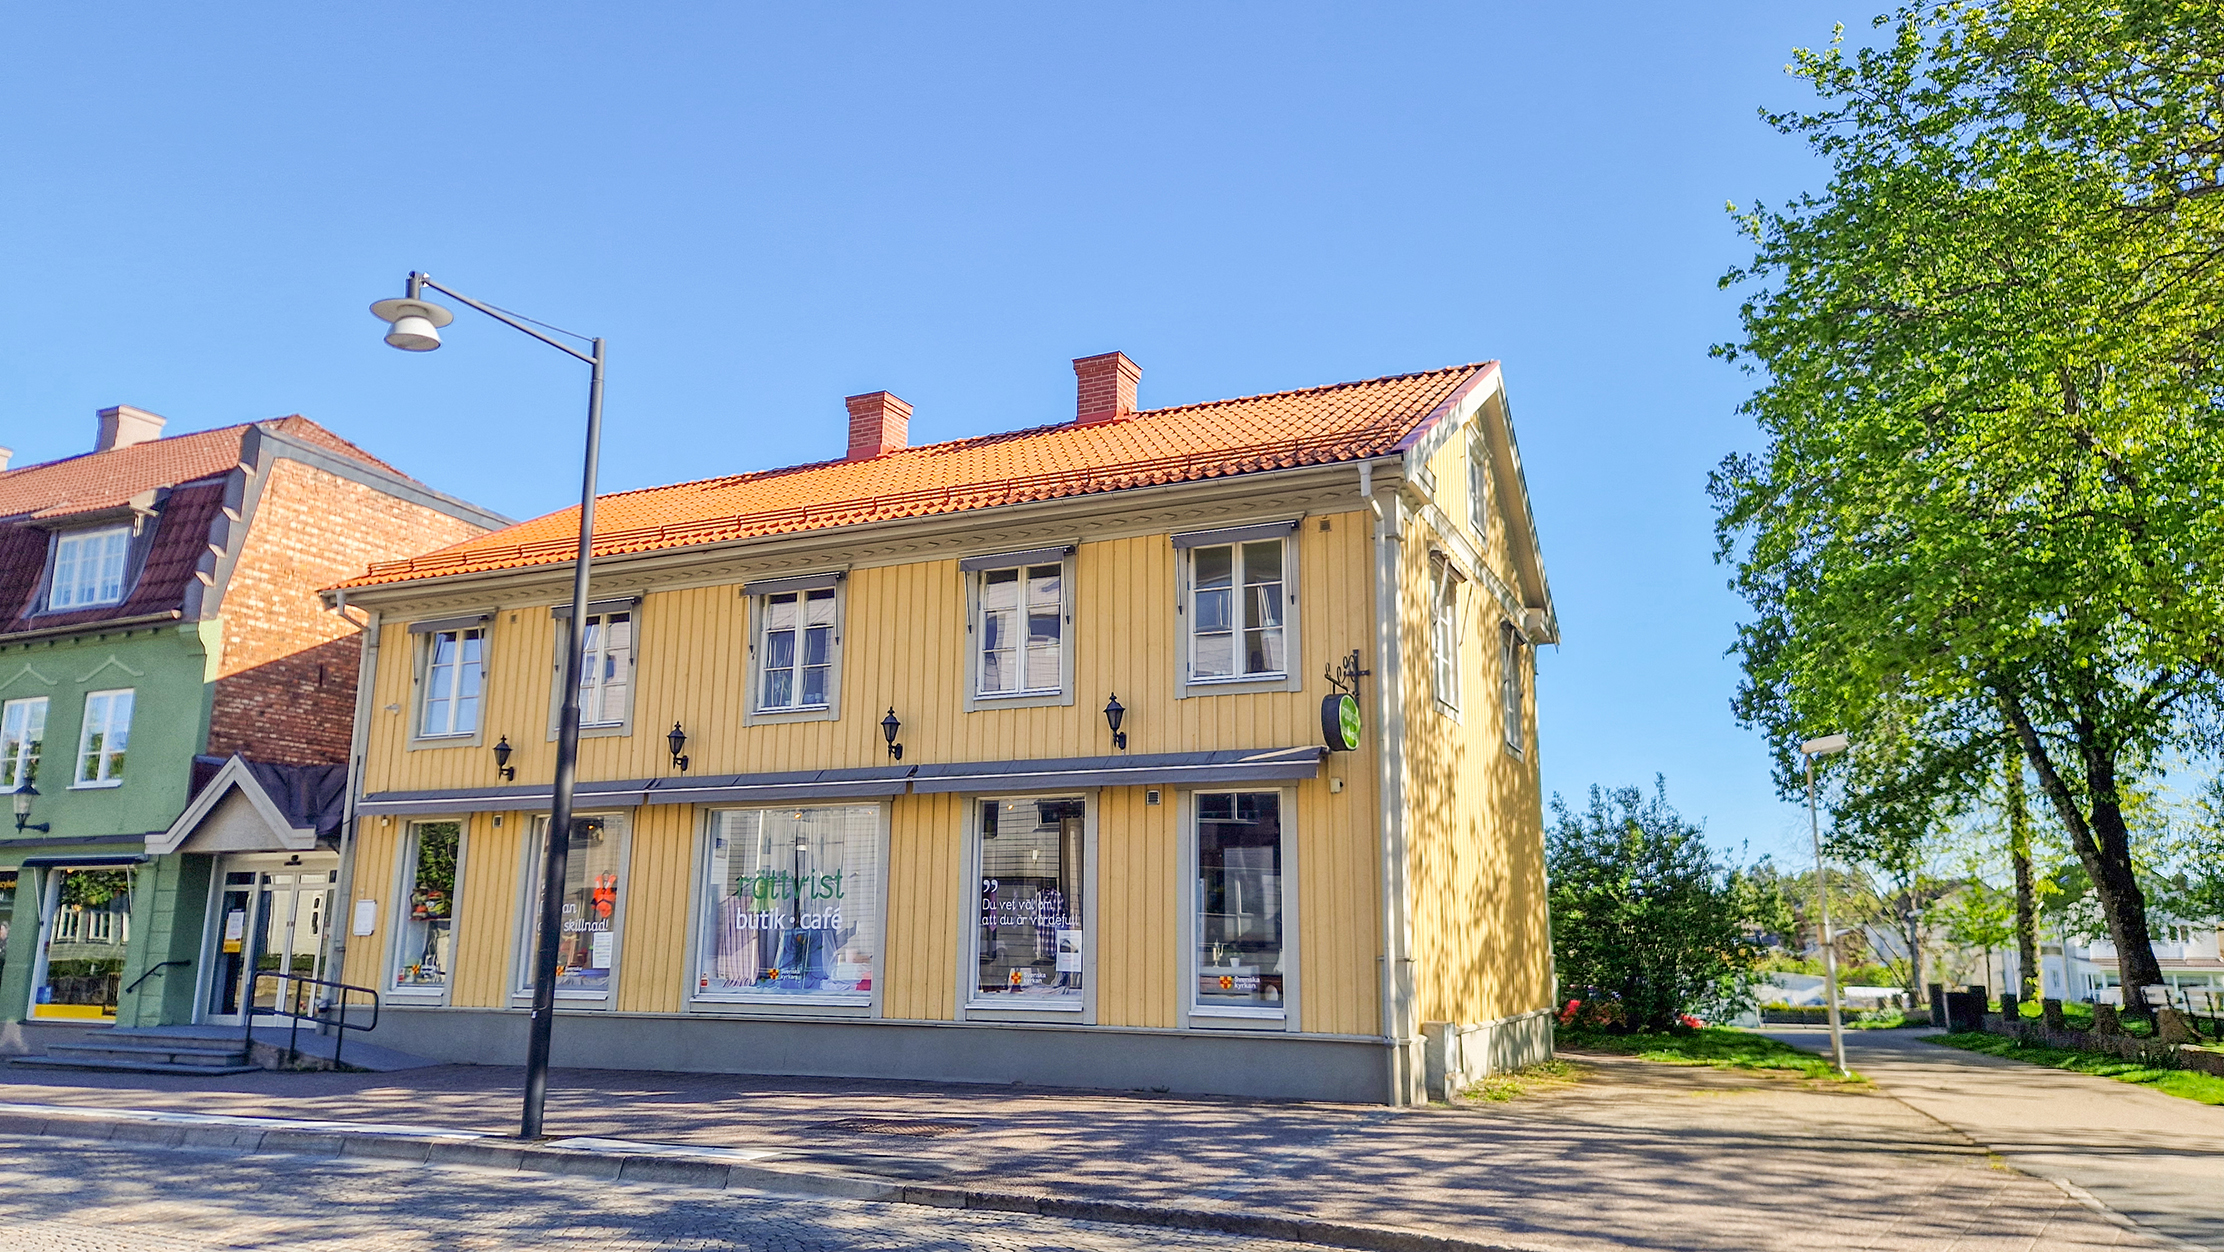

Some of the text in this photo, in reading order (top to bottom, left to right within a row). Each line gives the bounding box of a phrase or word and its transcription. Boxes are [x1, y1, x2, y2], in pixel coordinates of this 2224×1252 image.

[737, 868, 845, 899] rättvist
[982, 898, 997, 910] Du
[1000, 898, 1016, 910] vet
[563, 918, 609, 932] skillnad!
[736, 906, 843, 930] butik café
[981, 914, 997, 926] att
[999, 914, 1014, 926] du
[1016, 914, 1028, 926] är
